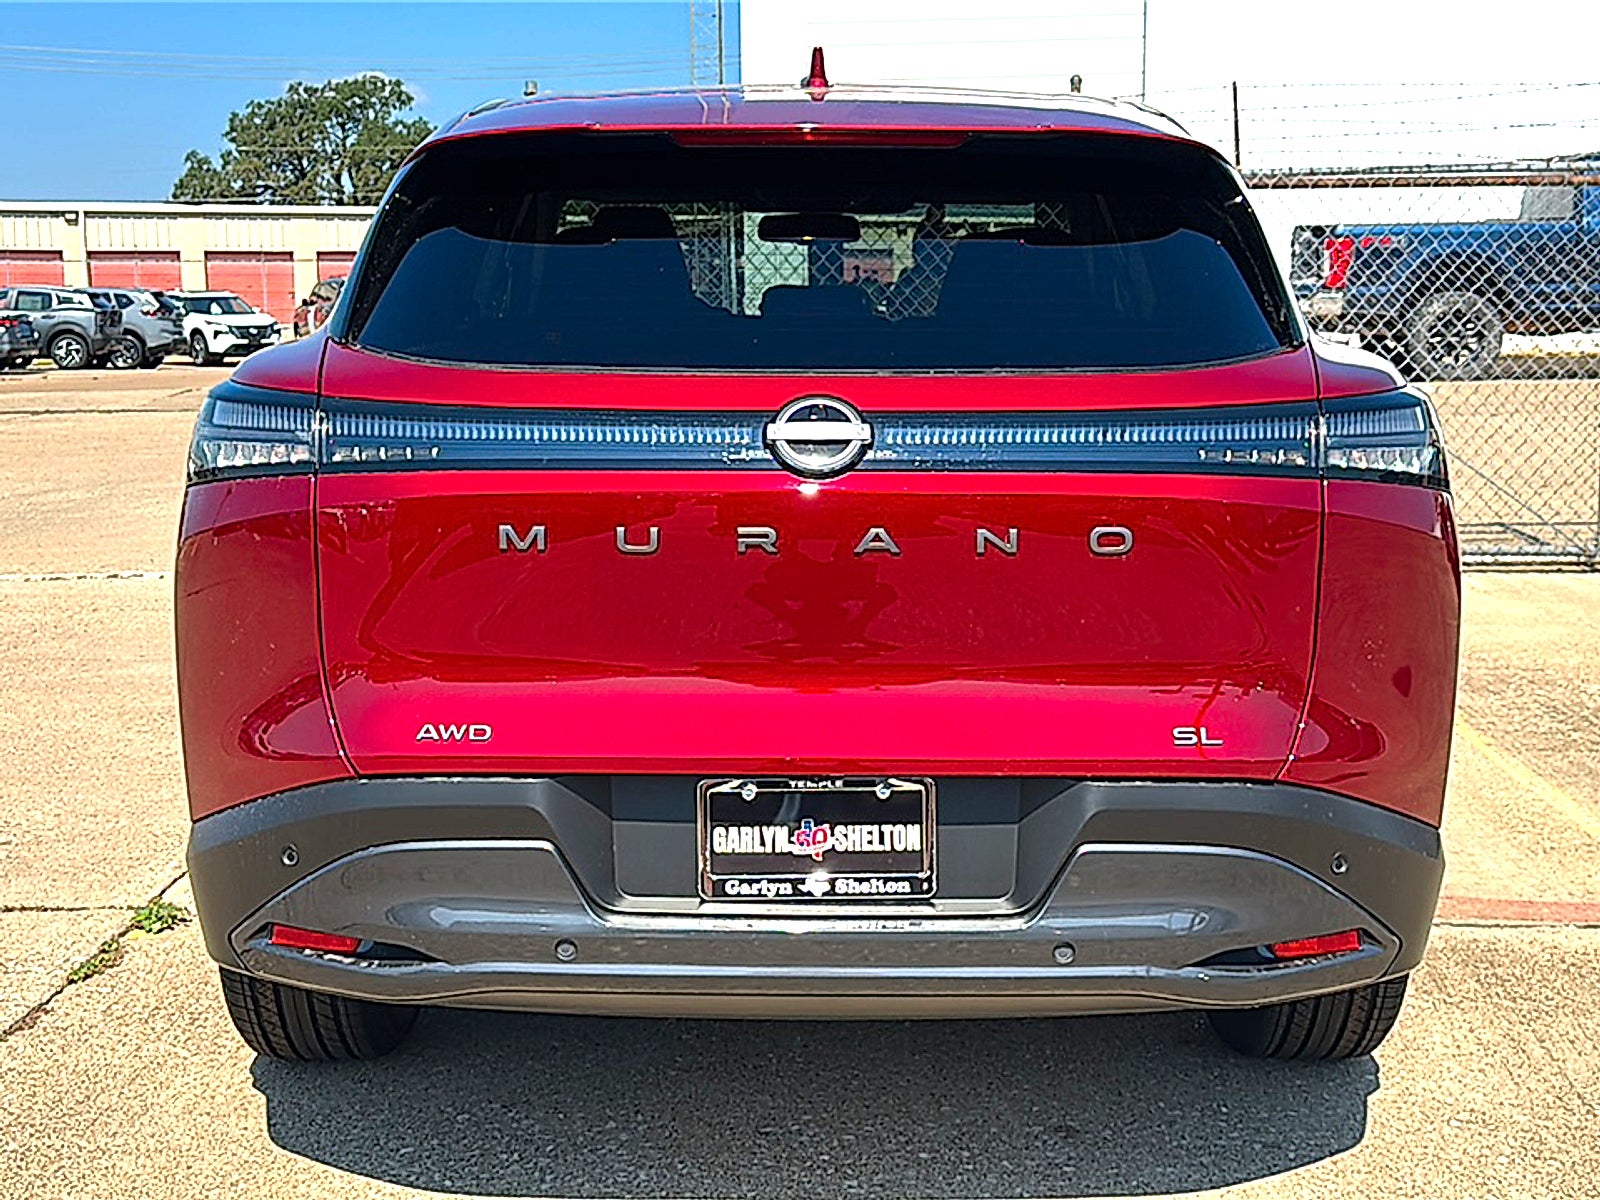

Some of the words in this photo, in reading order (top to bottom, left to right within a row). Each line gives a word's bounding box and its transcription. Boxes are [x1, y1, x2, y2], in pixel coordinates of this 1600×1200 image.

[498, 524, 1134, 556] MURANO
[415, 723, 493, 742] AWD
[1172, 726, 1224, 746] SL
[713, 825, 790, 853] GARLYN
[834, 824, 921, 851] SHELTON
[725, 879, 793, 897] Garlyn
[835, 878, 911, 894] Shelton
